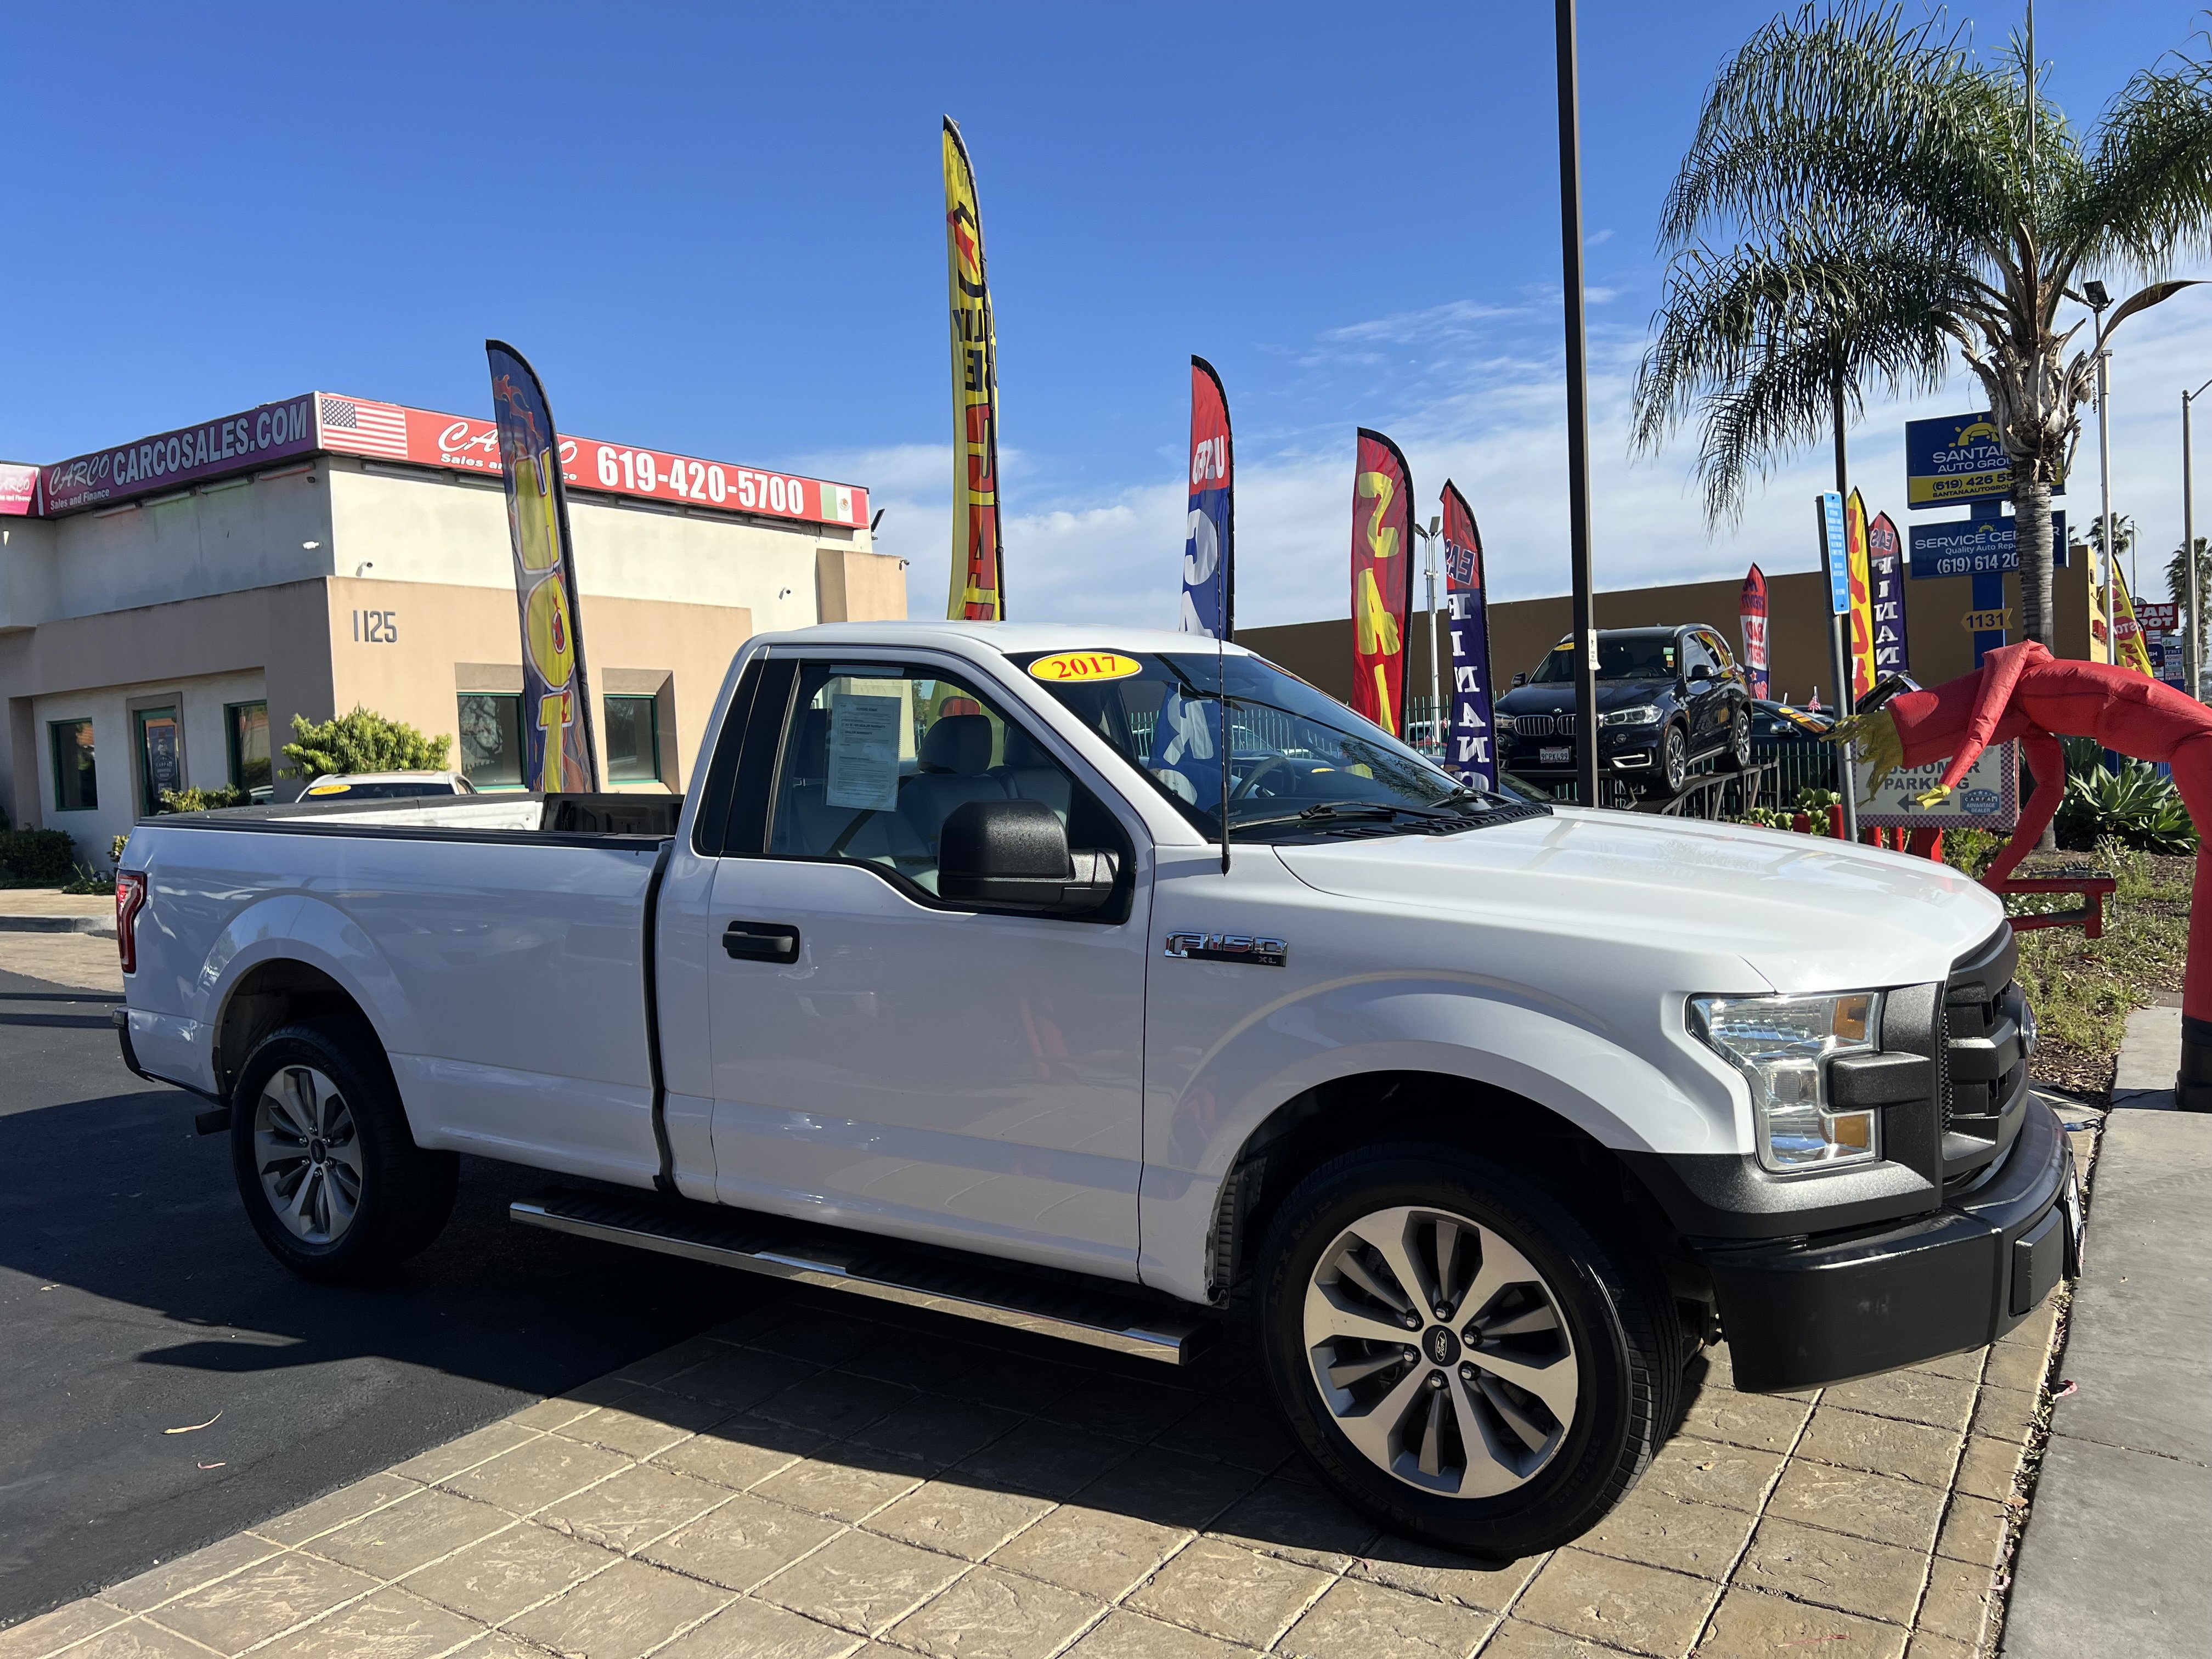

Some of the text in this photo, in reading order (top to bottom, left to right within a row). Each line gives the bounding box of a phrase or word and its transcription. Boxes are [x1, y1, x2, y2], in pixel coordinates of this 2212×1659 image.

[113, 401, 308, 486] CARCOSALES.COM
[438, 421, 578, 464] CAO
[440, 453, 503, 470] Sales an
[1933, 445, 2003, 464] SANTA
[49, 454, 110, 496] CARCO
[1937, 458, 2012, 473] AUTO GROU
[596, 445, 804, 515] 619-420-5700
[1932, 472, 2014, 492] (619) 426 55
[50, 488, 110, 511] Sales and Finance
[1915, 533, 1987, 550] SERVICE
[1945, 546, 1975, 556] Quality
[1976, 544, 1996, 552] Auto
[1937, 552, 2019, 574] (619) 614 20
[353, 609, 398, 644] 1125
[1966, 612, 2004, 629] 1131
[1051, 656, 1115, 679] 2017
[1884, 777, 1970, 791] PARKIG
[1258, 956, 1277, 964] XL
[1437, 1336, 1446, 1356] Ford
